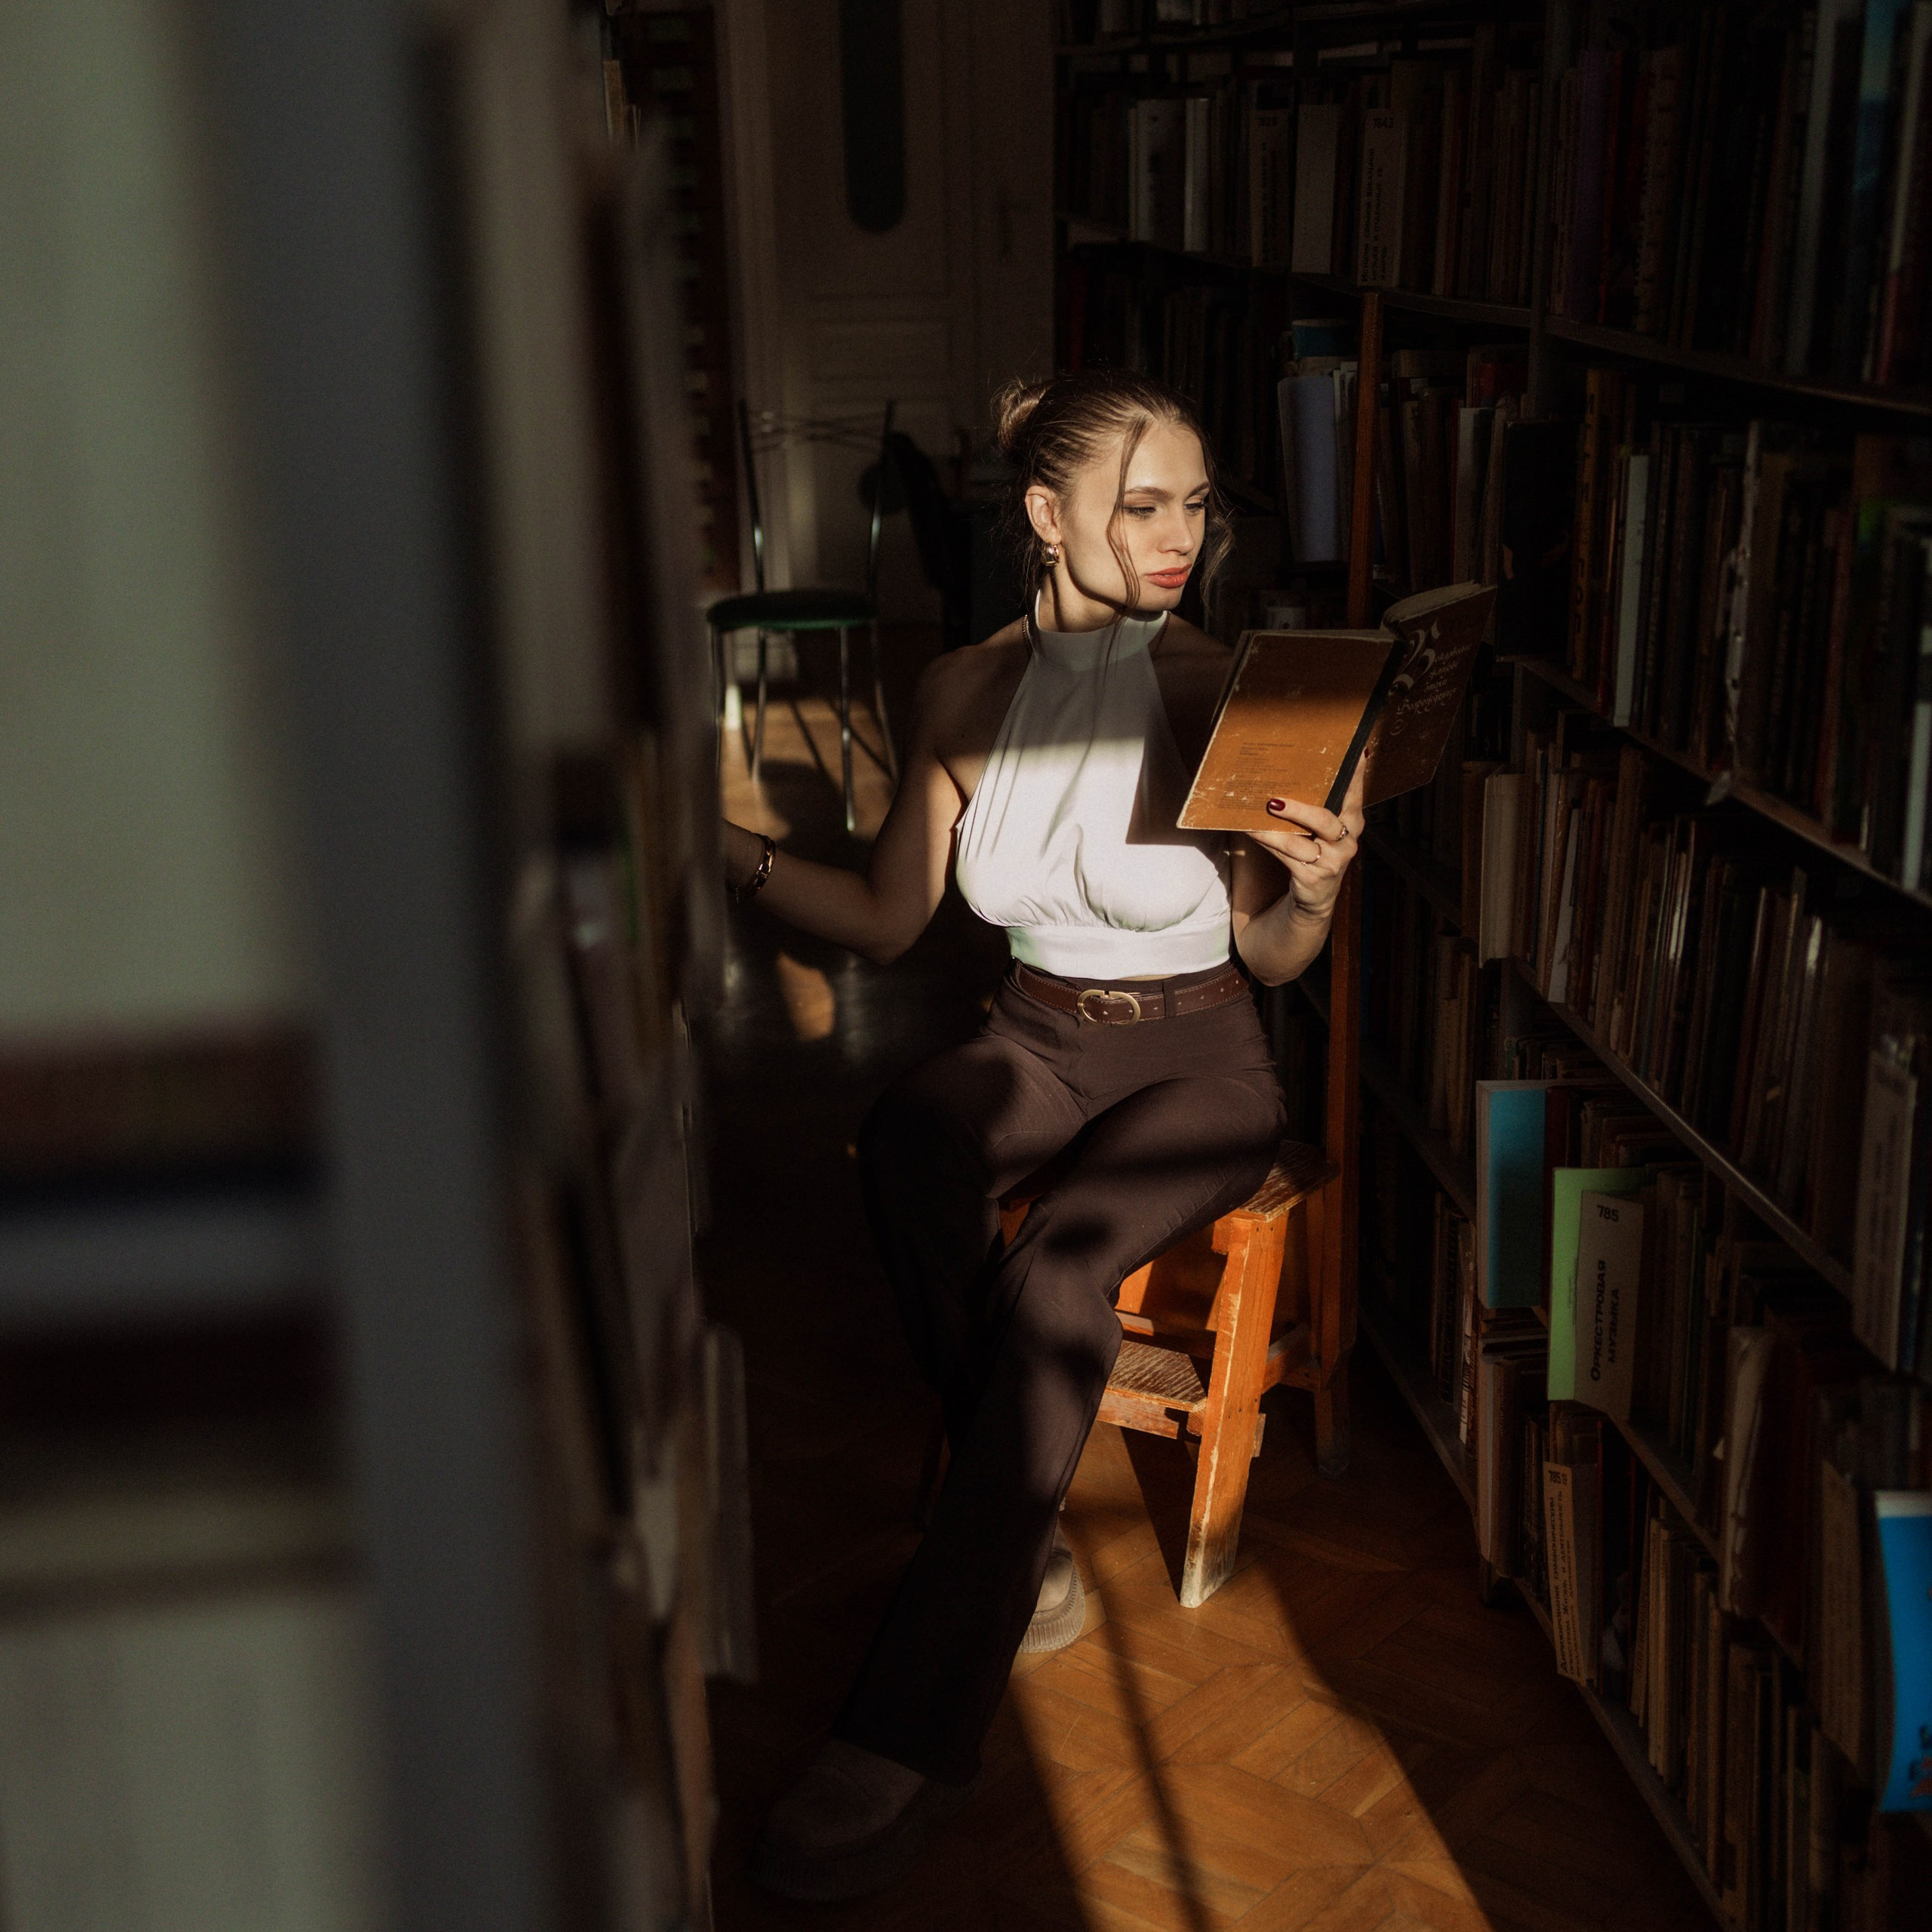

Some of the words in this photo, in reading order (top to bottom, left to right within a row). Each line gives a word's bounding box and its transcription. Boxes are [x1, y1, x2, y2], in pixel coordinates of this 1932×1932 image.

[1596, 1204, 1620, 1223] 785
[1590, 1260, 1607, 1382] ОРКЕСТРОВАЯ
[1607, 1287, 1620, 1364] МУЗЫКА
